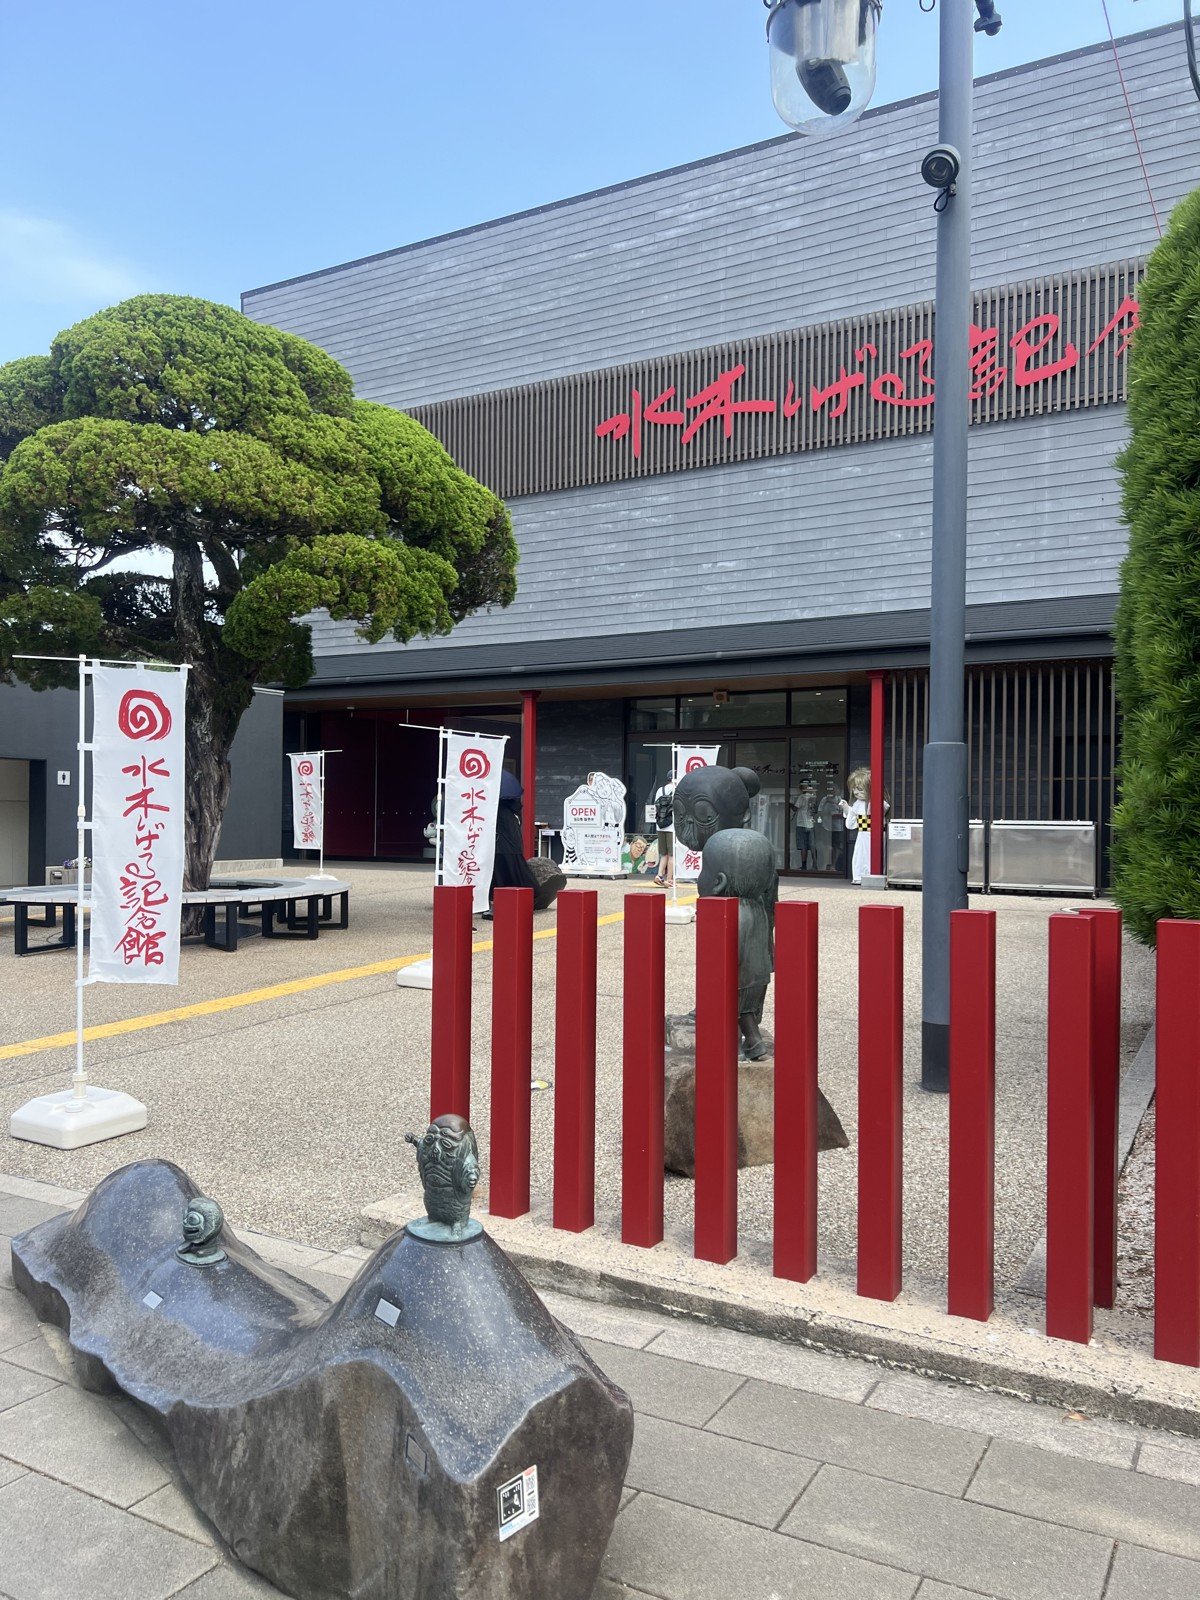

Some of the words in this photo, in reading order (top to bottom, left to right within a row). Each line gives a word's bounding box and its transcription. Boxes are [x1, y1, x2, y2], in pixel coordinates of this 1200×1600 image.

[114, 755, 170, 965] 水木しげる記念館
[457, 787, 487, 887] 水木しげる記念
[571, 807, 596, 816] OPEN
